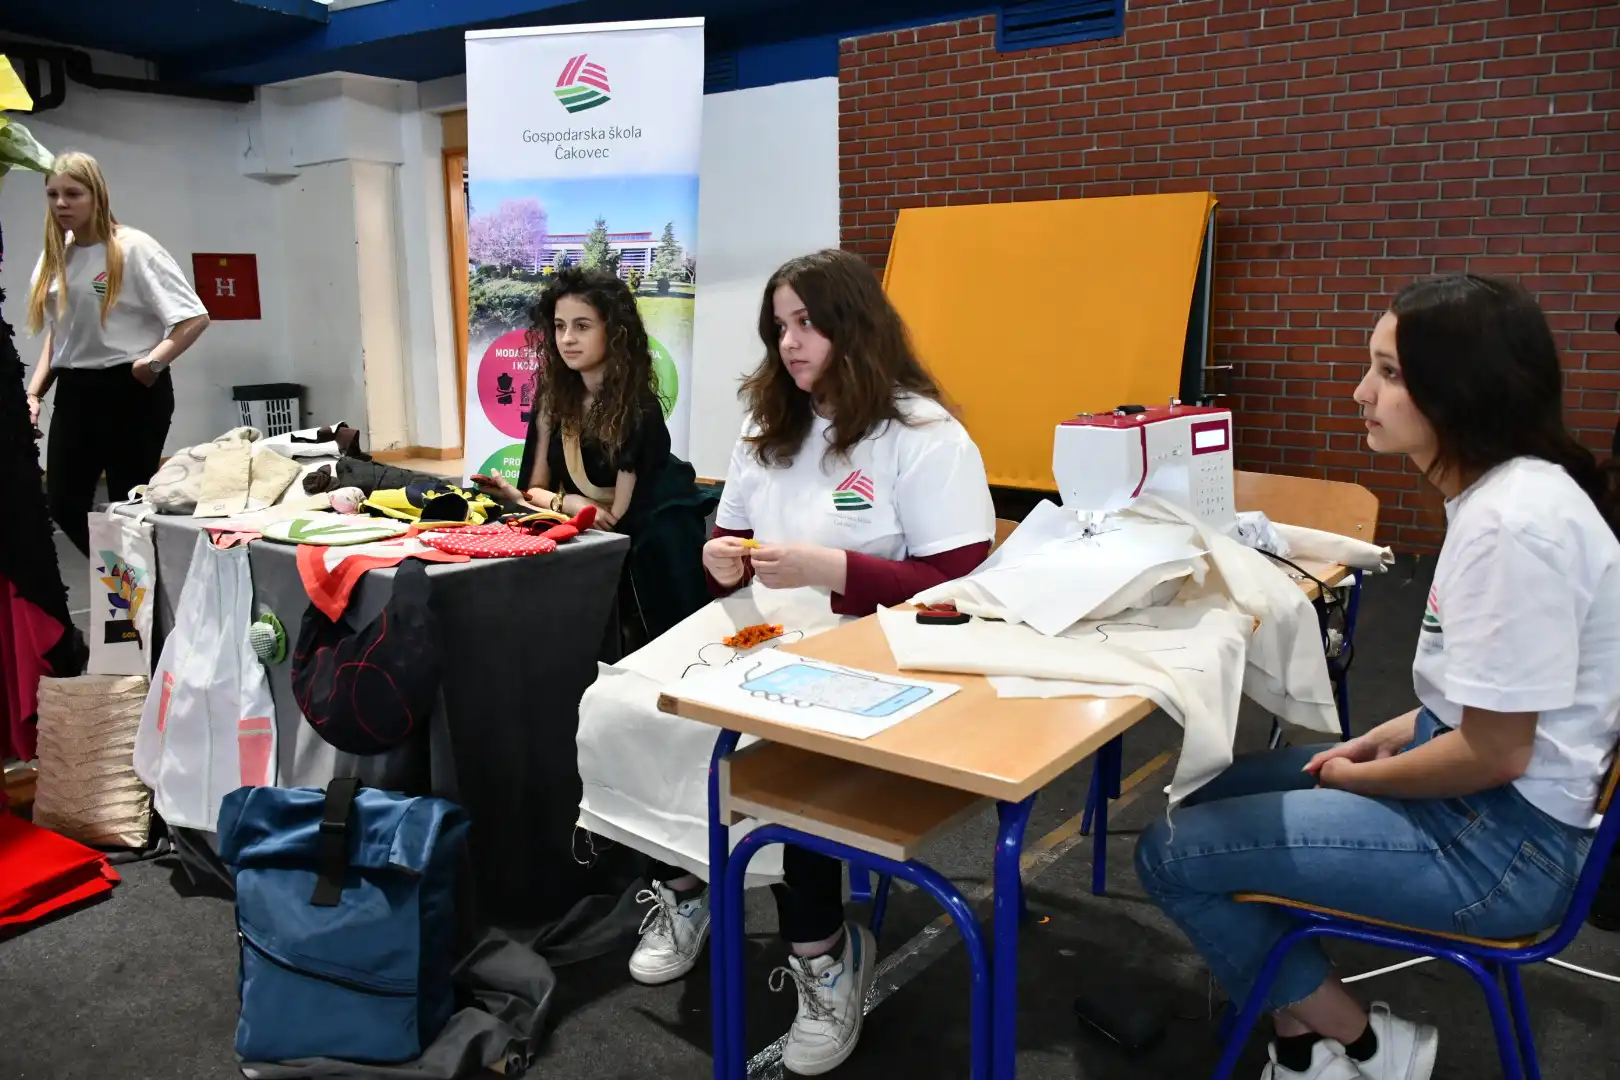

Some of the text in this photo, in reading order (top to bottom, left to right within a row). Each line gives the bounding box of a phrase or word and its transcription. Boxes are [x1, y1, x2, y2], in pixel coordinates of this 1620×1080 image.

[522, 125, 642, 145] Gospodarska škola
[555, 144, 610, 160] Čakovec
[214, 277, 236, 297] H
[512, 361, 516, 370] I
[503, 457, 522, 466] PRO
